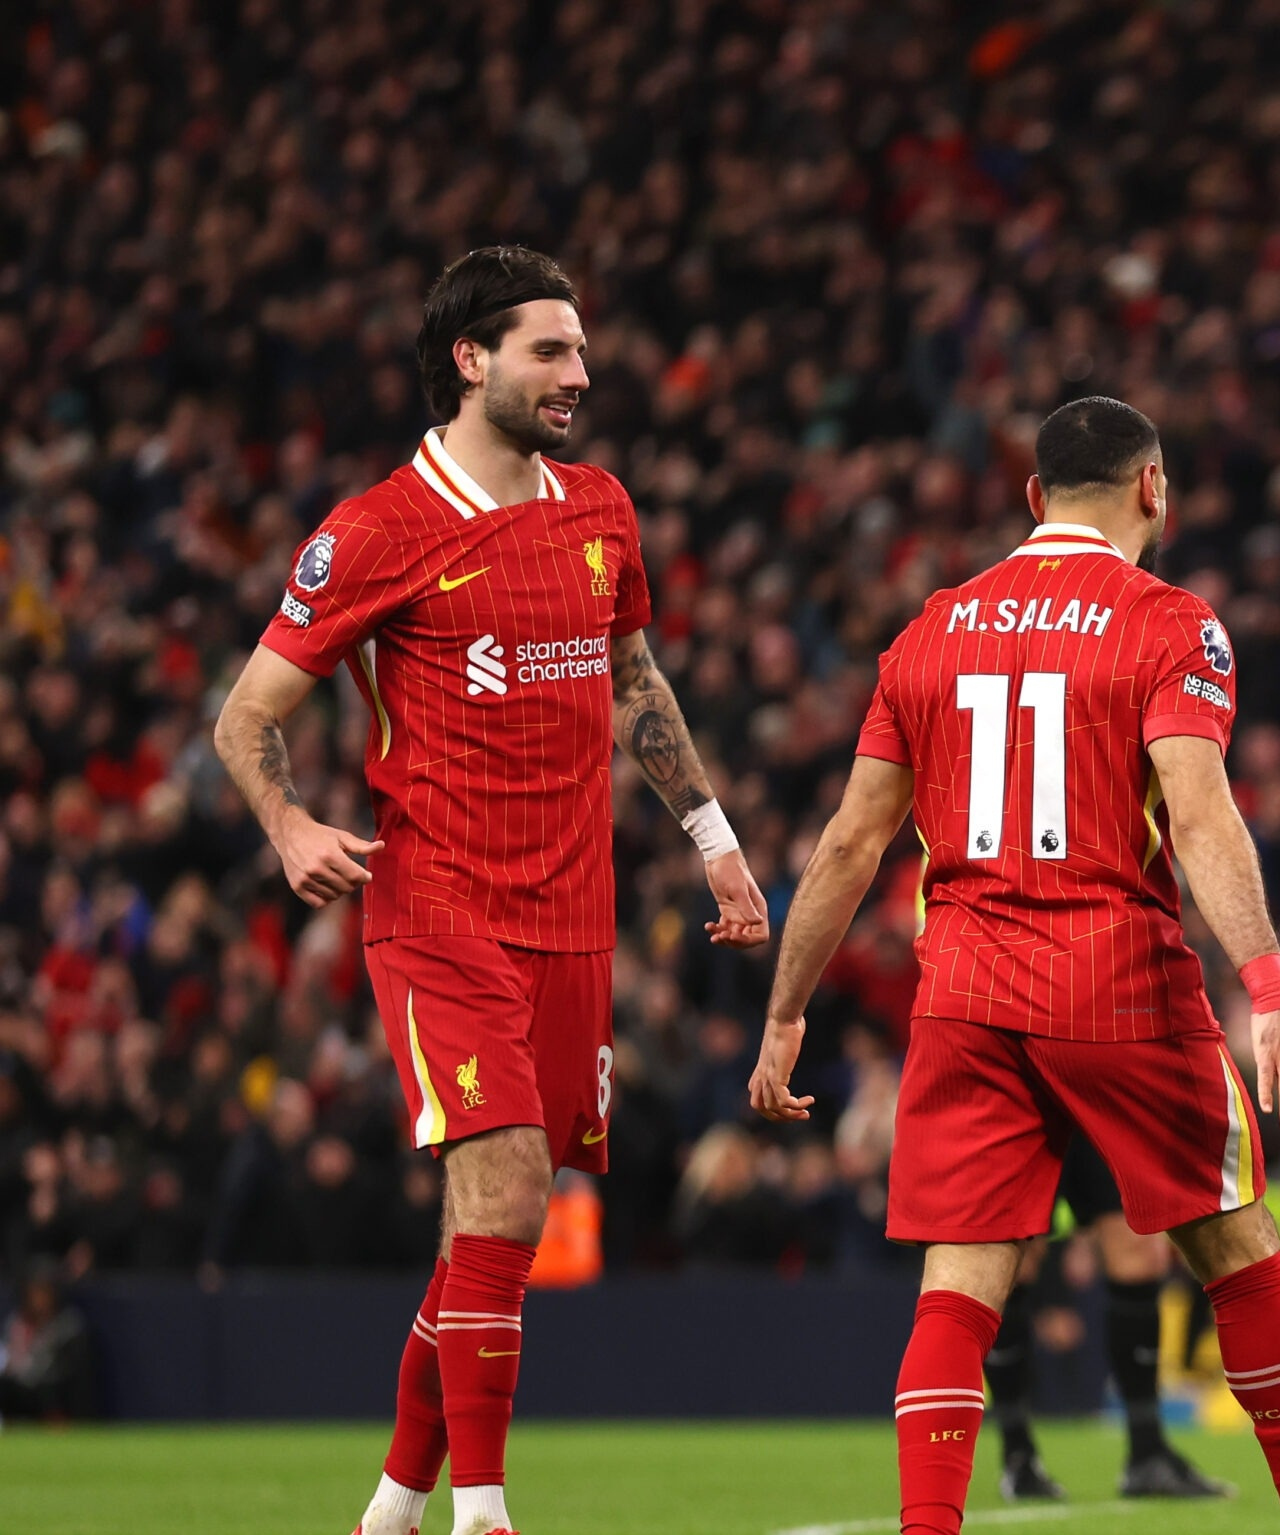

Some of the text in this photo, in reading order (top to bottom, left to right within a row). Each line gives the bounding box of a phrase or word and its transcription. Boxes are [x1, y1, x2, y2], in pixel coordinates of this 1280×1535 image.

[946, 597, 1113, 637] M.SALAH
[515, 631, 607, 662] standard
[518, 652, 608, 683] chartered
[1185, 673, 1202, 688] No
[955, 671, 1067, 860] 11
[597, 1045, 614, 1119] 8
[929, 1430, 966, 1443] LFC
